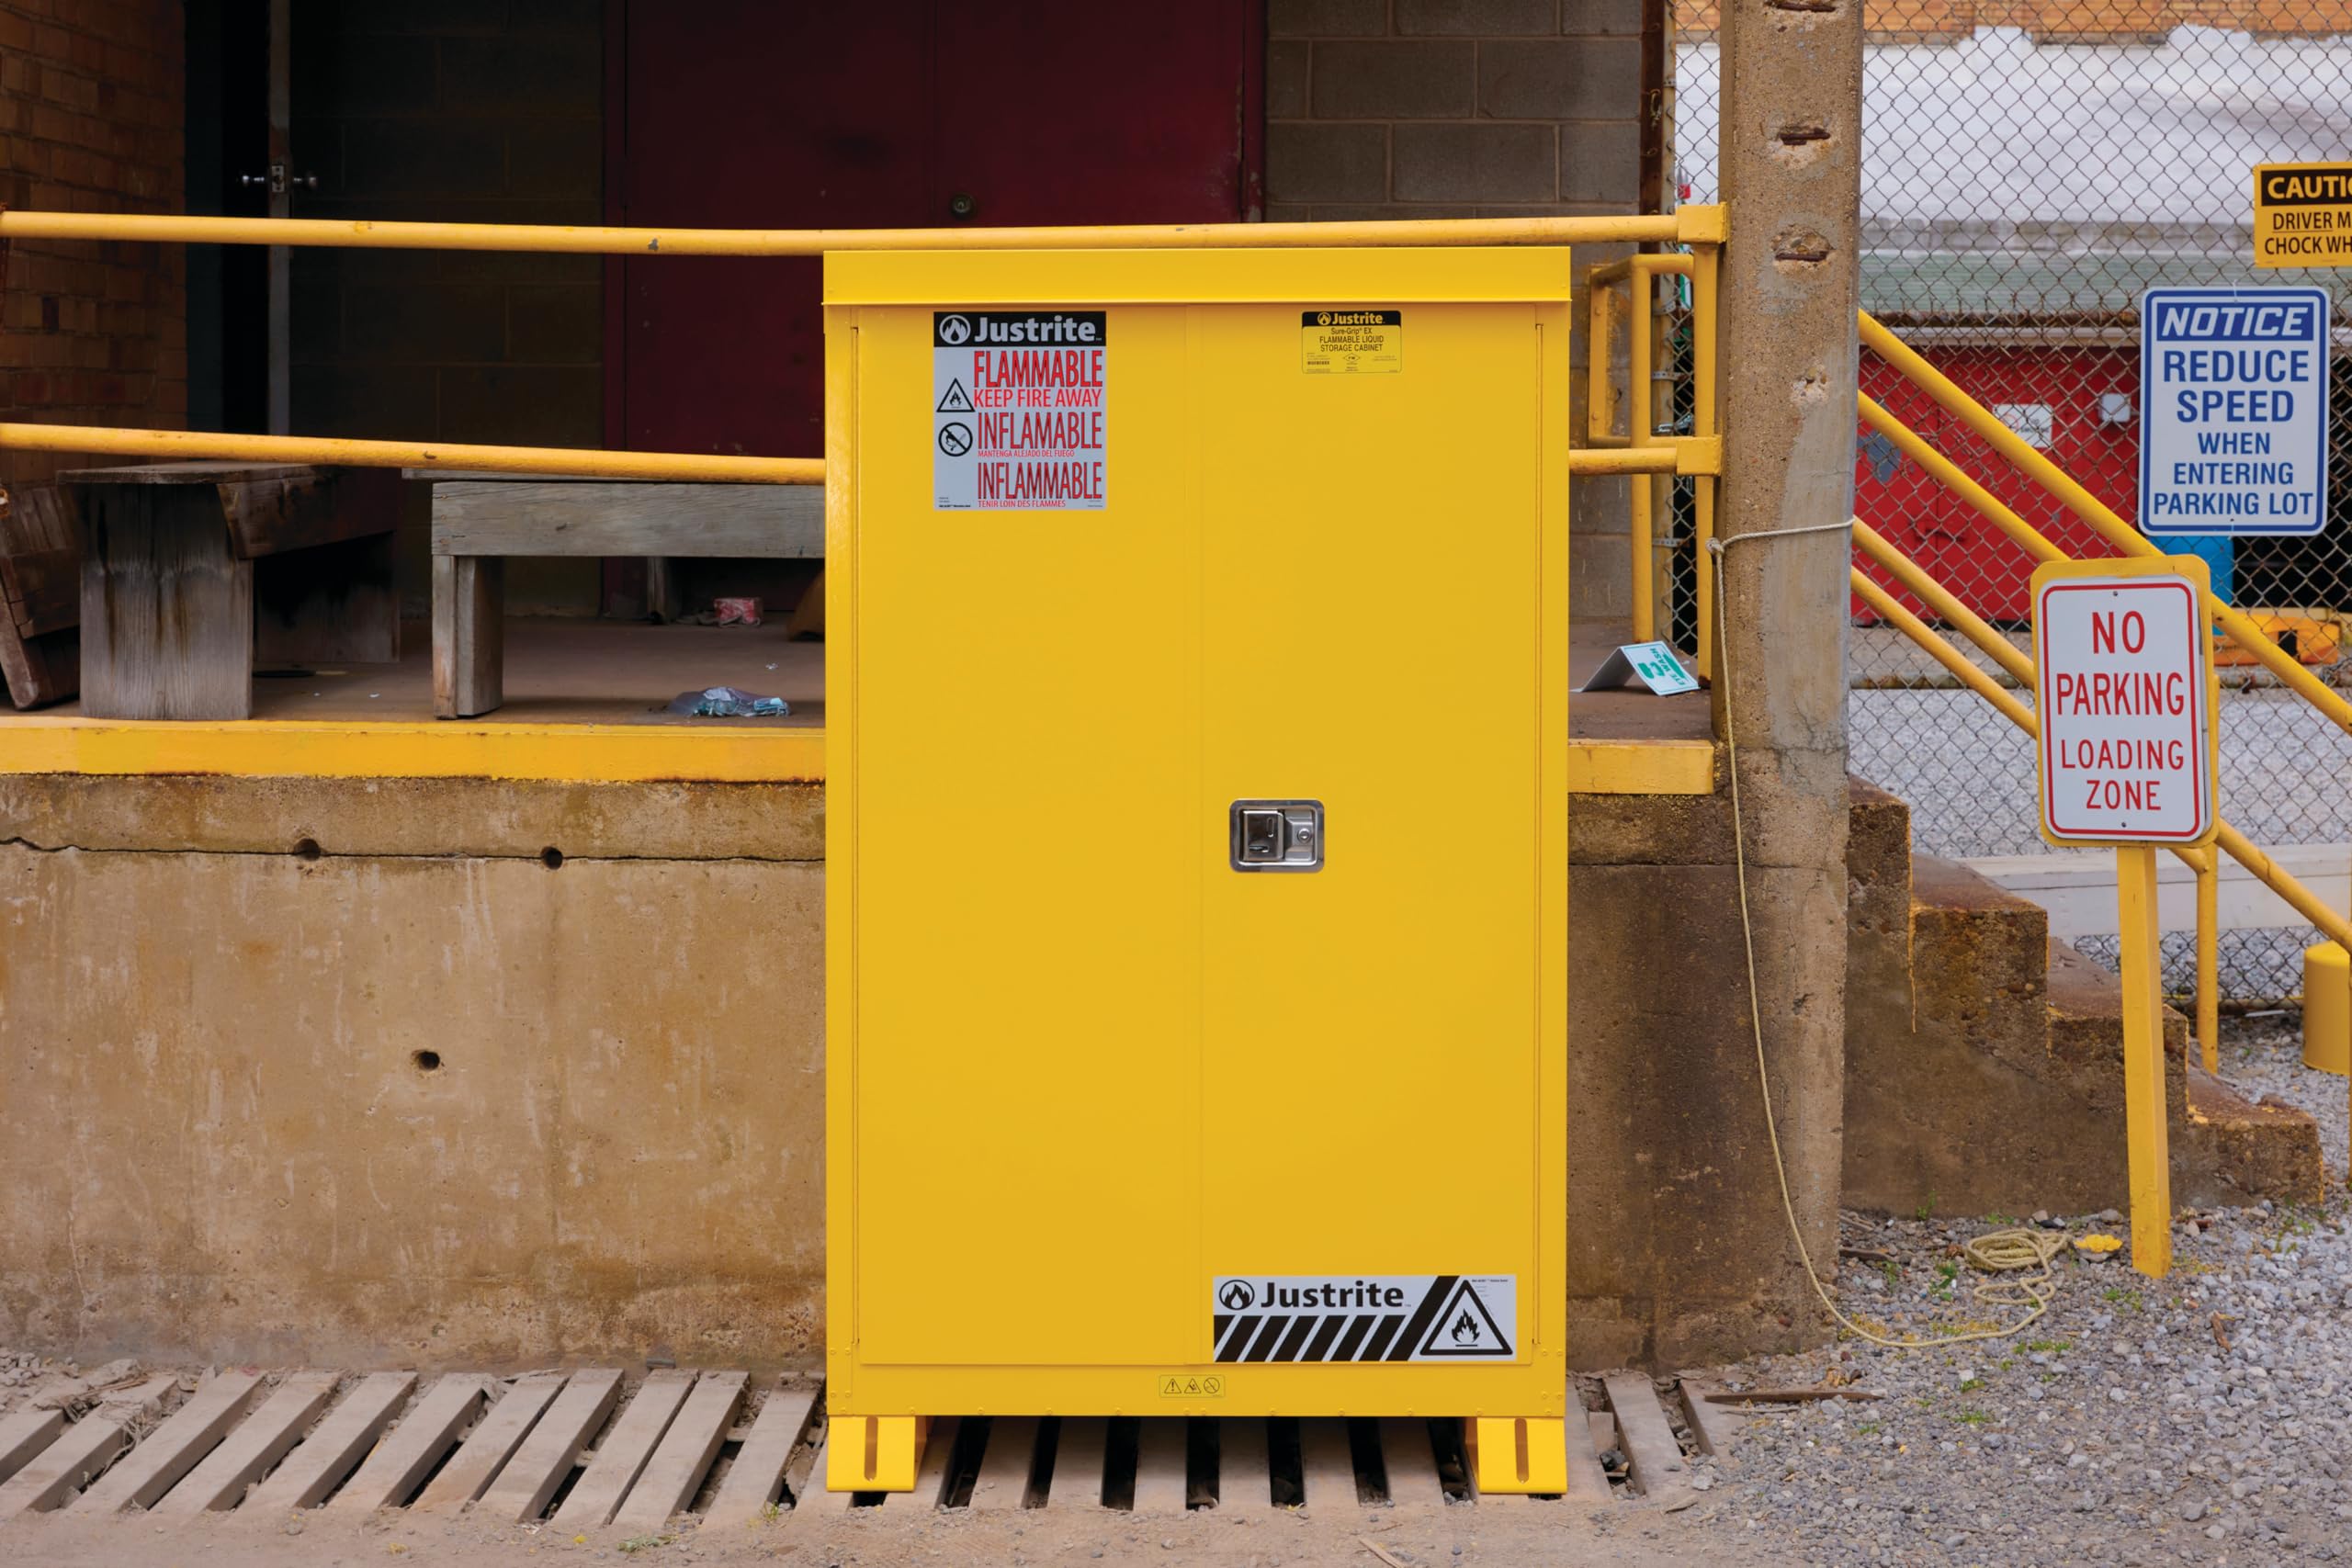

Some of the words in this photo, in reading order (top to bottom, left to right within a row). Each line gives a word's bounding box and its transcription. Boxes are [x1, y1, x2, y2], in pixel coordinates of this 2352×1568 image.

[2267, 175, 2352, 199] CAUTI
[2273, 211, 2333, 231] DRIVER
[2265, 236, 2323, 255] CHOCK
[974, 315, 1096, 343] Justrite
[1332, 312, 1384, 324] Justrite
[2161, 307, 2309, 337] NOTICE
[1319, 335, 1361, 344] FLAMMABLE
[1362, 335, 1385, 344] LIQUID
[1320, 344, 1352, 353] STORAGE
[1354, 344, 1384, 352] CABINET
[974, 350, 1102, 388] FLAMMABLE
[2163, 350, 2310, 383] REDUCE
[974, 389, 1013, 408] KEEP
[1017, 389, 1051, 408] FIRE
[1055, 389, 1102, 408] AWAY
[2177, 389, 2294, 423] SPEED
[978, 412, 1102, 449] INFLAMABLE
[2197, 432, 2271, 455] WHEN
[978, 462, 1102, 499] INFLAMMABLE
[2173, 462, 2294, 486] ENTERING
[978, 500, 999, 508] TENIR
[1000, 500, 1015, 508] LOIN
[1017, 500, 1031, 508] DES
[1032, 500, 1066, 508] FLAMMES
[2154, 491, 2260, 516] PARKING
[2268, 491, 2314, 515] LOT
[2092, 610, 2145, 655] NO
[2056, 671, 2185, 716] PARKING
[2061, 739, 2184, 772] LOADING
[2086, 780, 2162, 811] ZONE
[1261, 1280, 1405, 1308] Justrite
